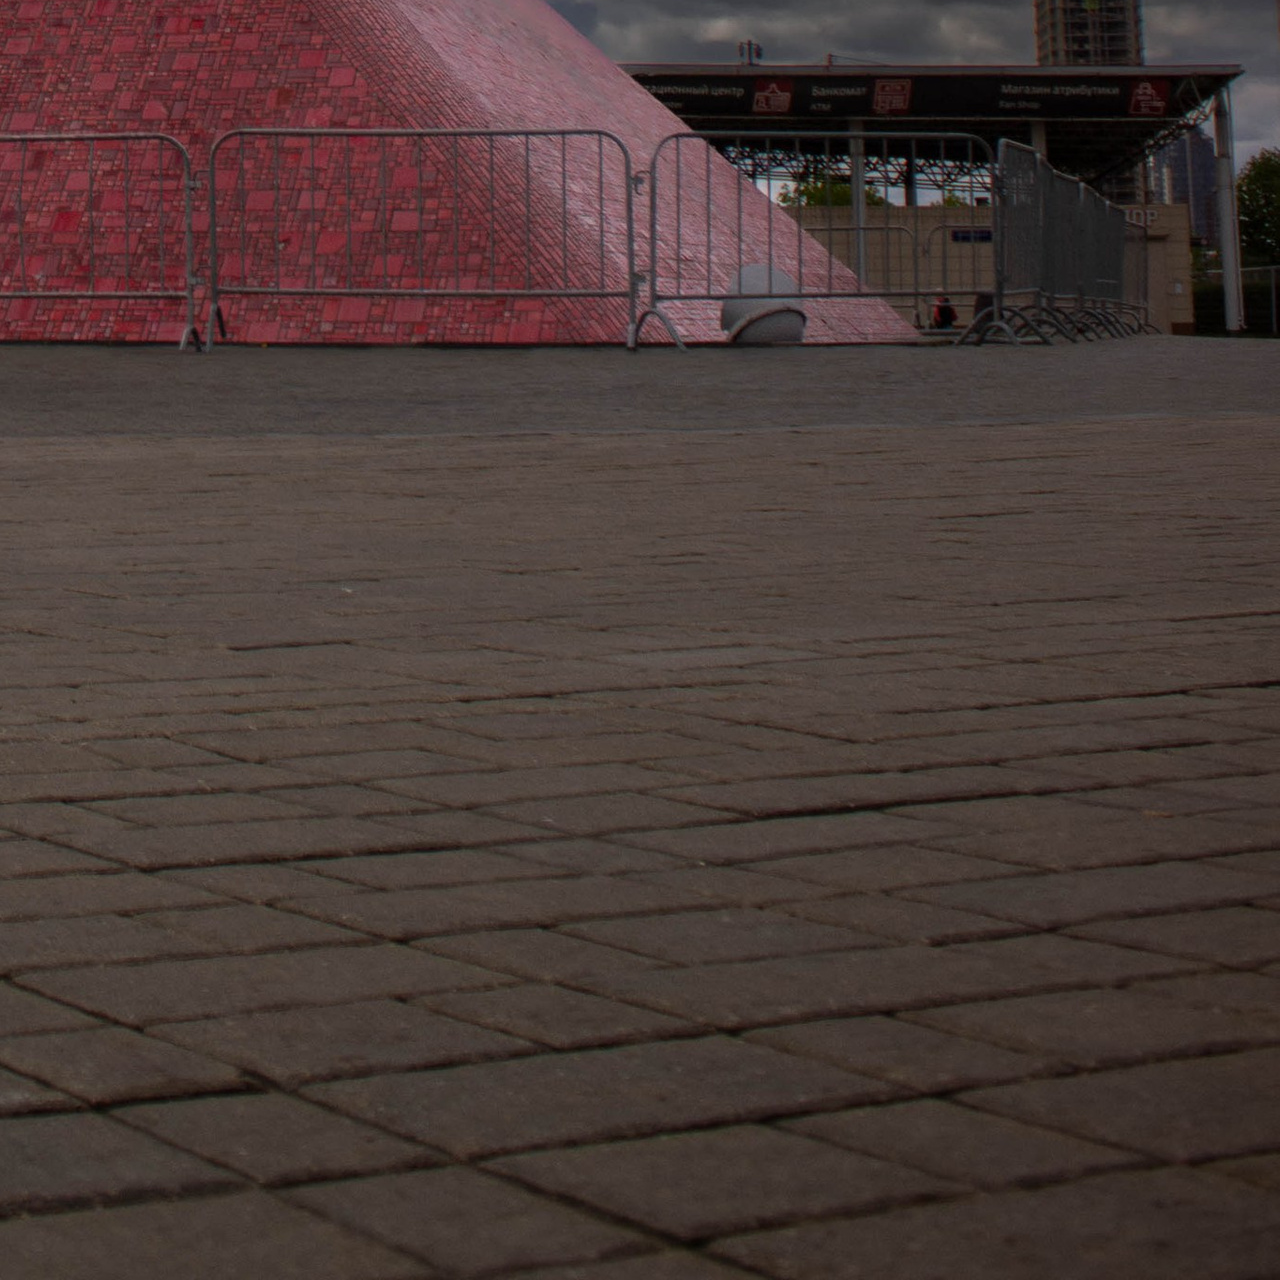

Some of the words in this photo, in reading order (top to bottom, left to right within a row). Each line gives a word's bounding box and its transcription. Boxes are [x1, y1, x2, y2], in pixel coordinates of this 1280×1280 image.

[711, 86, 745, 98] центр
[811, 85, 867, 96] Банкомат
[1000, 84, 1051, 95] Магазин
[1052, 84, 1120, 96] атрибутики
